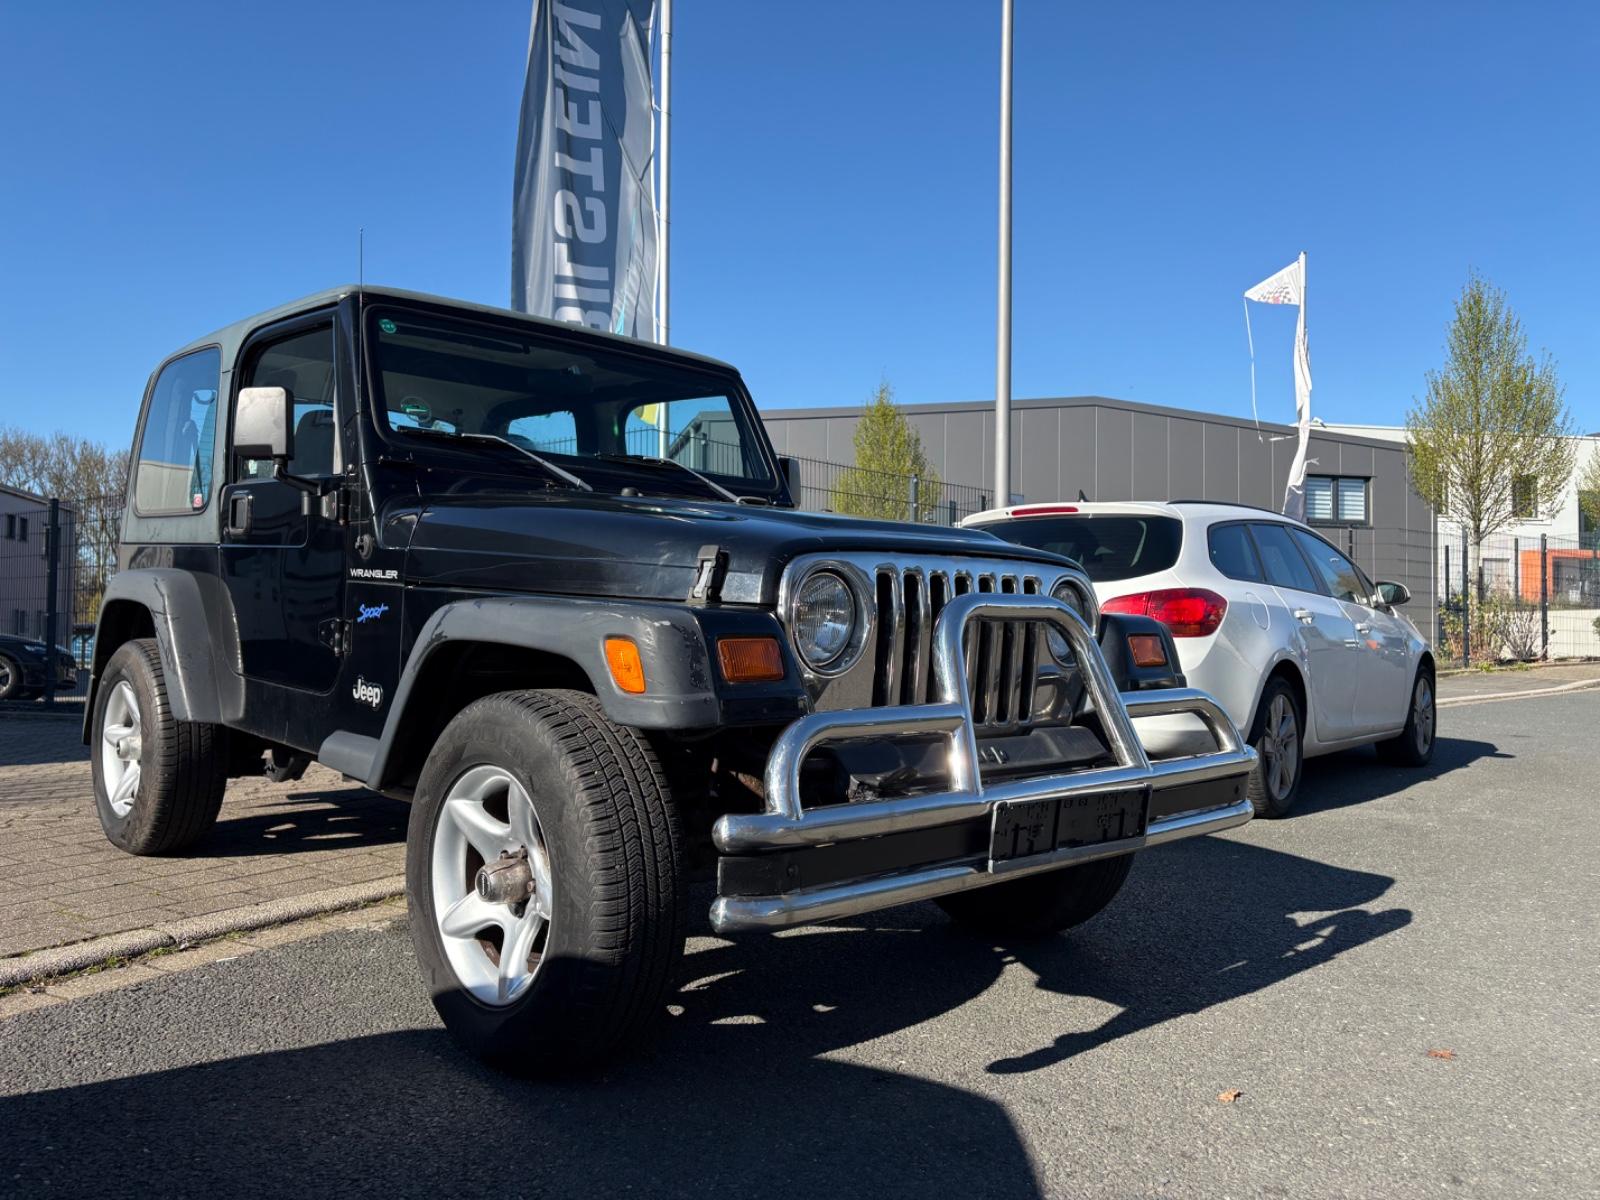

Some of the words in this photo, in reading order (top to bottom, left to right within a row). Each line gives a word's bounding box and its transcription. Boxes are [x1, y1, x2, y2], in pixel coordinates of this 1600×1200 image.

[350, 568, 398, 579] WRANGLER
[357, 603, 389, 623] Sport
[352, 678, 381, 707] Jeep
